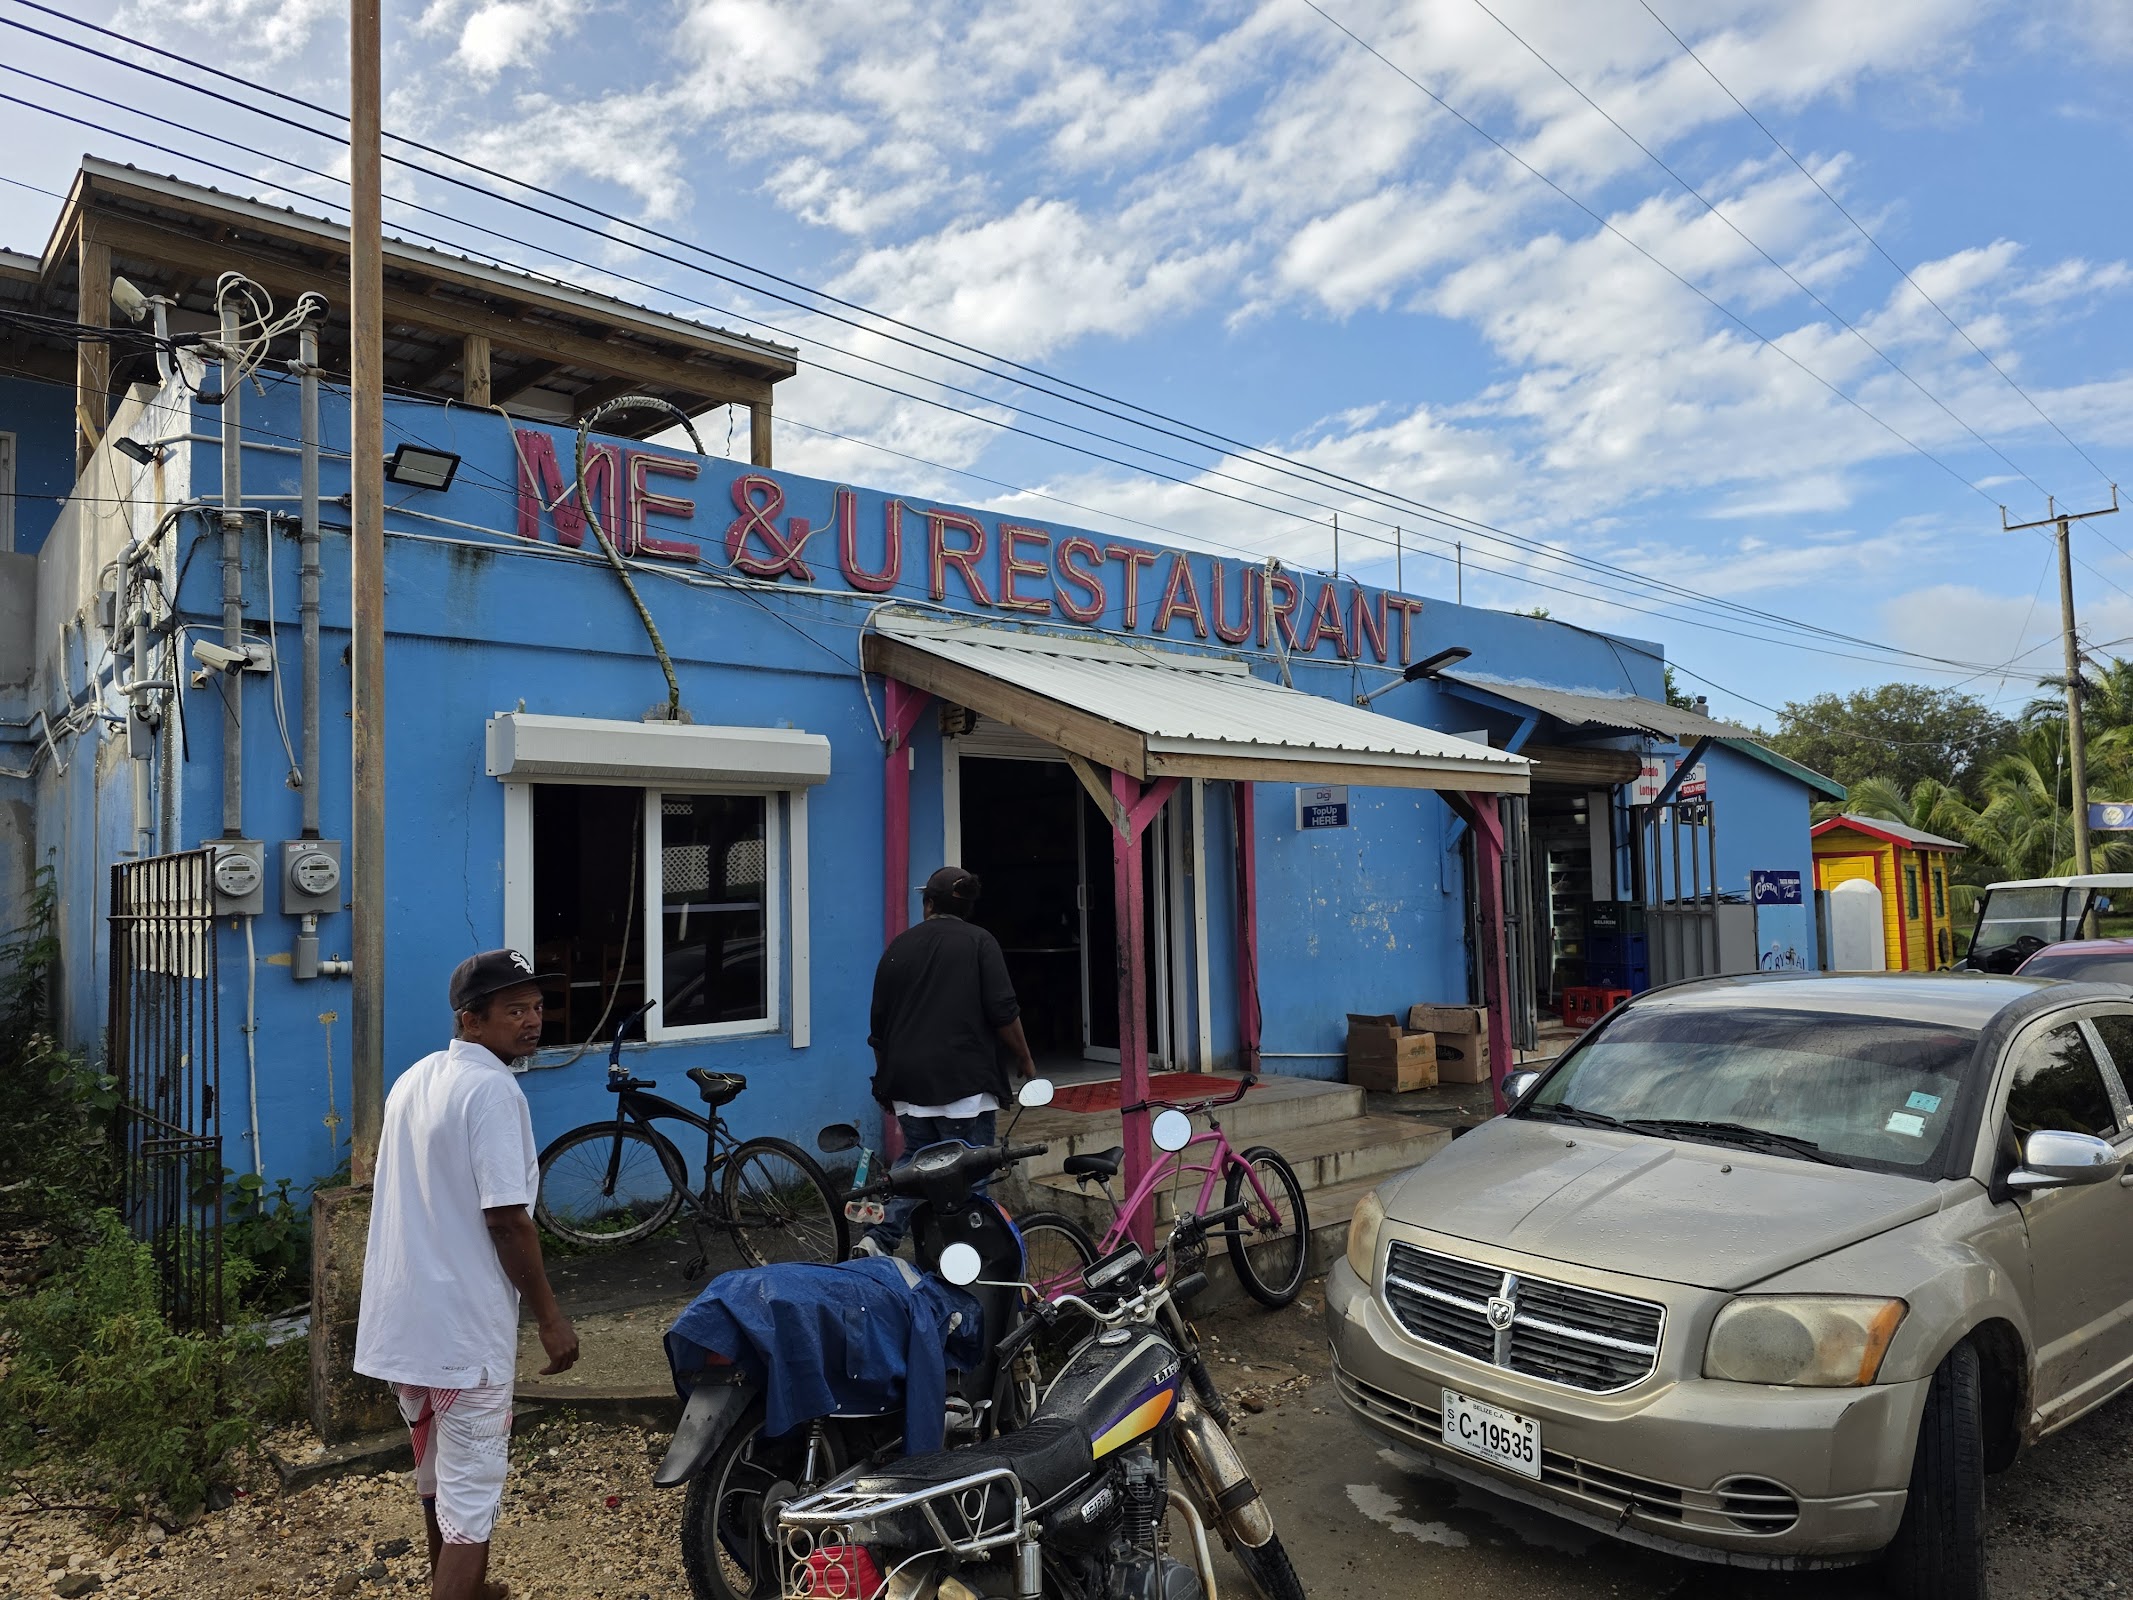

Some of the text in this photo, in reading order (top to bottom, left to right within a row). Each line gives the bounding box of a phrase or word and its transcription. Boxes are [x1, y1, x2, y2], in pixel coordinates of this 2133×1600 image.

[516, 428, 1424, 665] ME & U RESTAURANT
[1312, 806, 1338, 816] TopUp
[1312, 815, 1338, 826] HERE
[1447, 1408, 1455, 1419] S
[1472, 1404, 1506, 1421] BELIZE C.A.
[1447, 1421, 1455, 1432] C
[1459, 1412, 1533, 1463] C-19535
